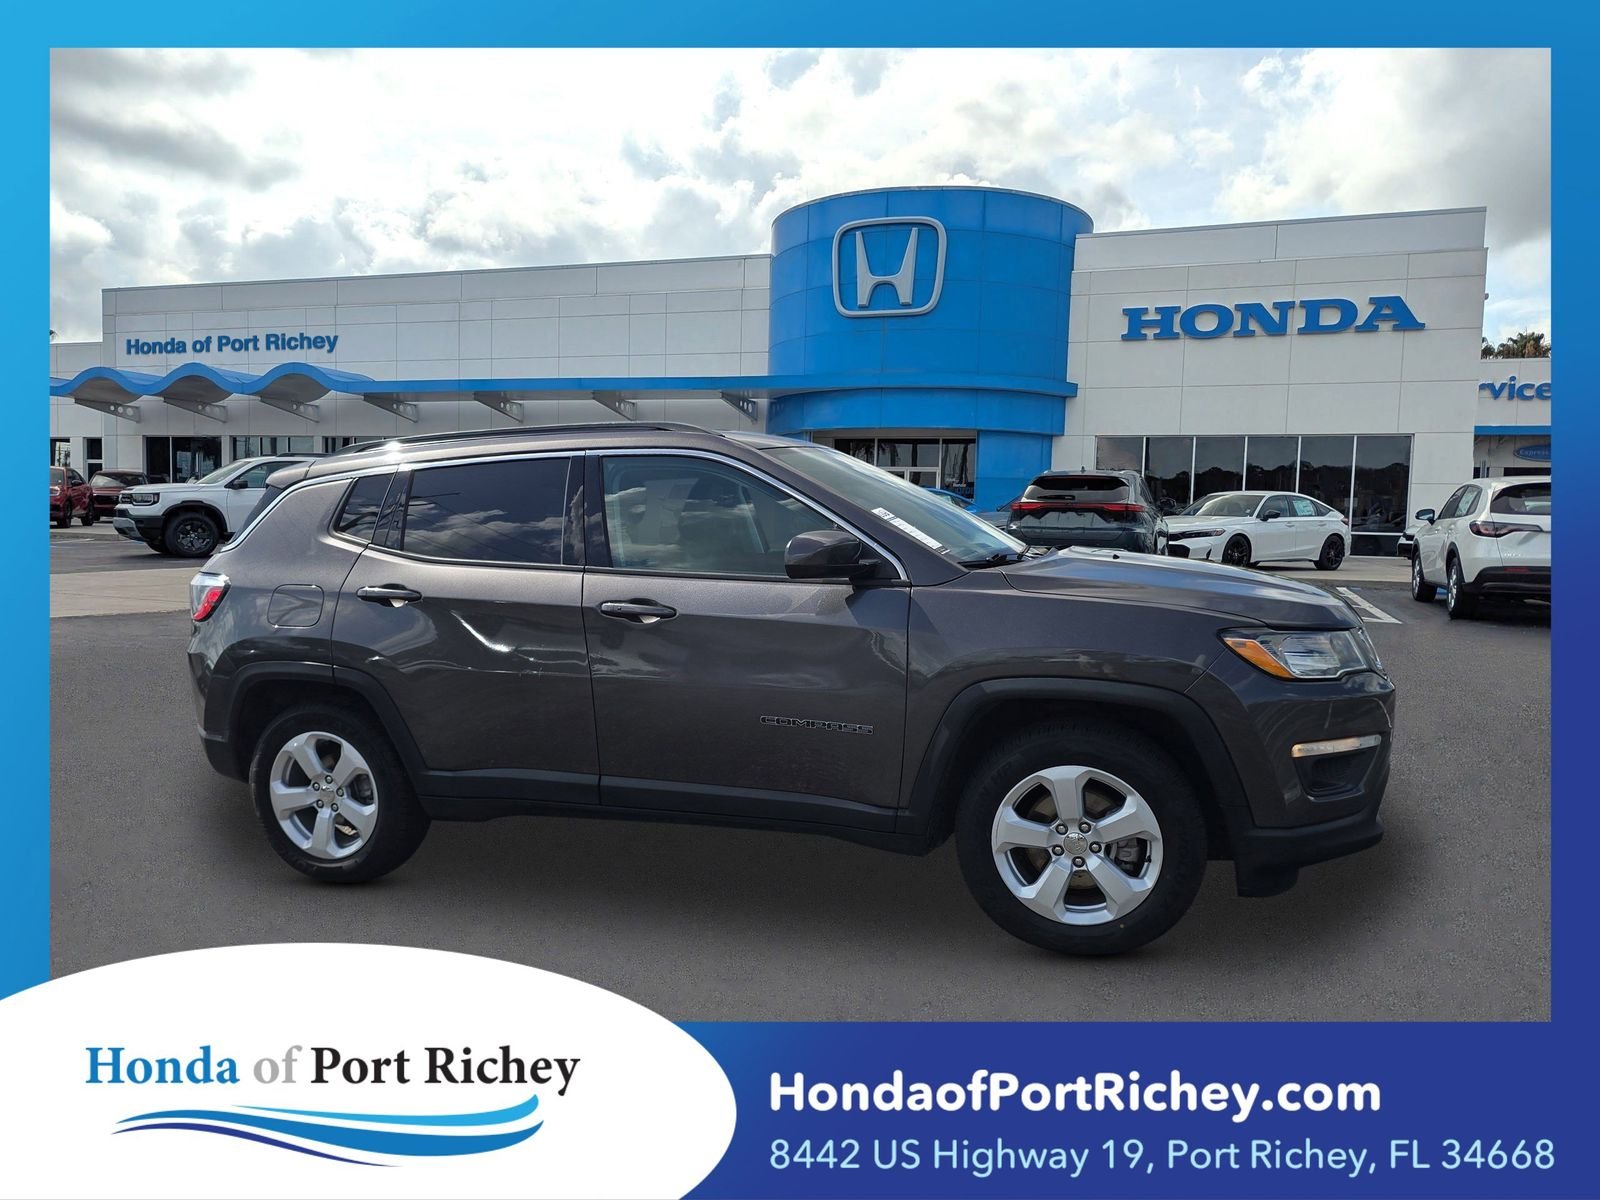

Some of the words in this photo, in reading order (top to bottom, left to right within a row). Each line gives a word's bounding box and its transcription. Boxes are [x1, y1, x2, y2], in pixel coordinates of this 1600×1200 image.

[1121, 295, 1426, 341] HONDA
[126, 337, 187, 355] Honda
[192, 336, 212, 353] of
[217, 335, 260, 352] Port
[265, 332, 339, 353] Richey
[760, 715, 874, 735] COMPASS
